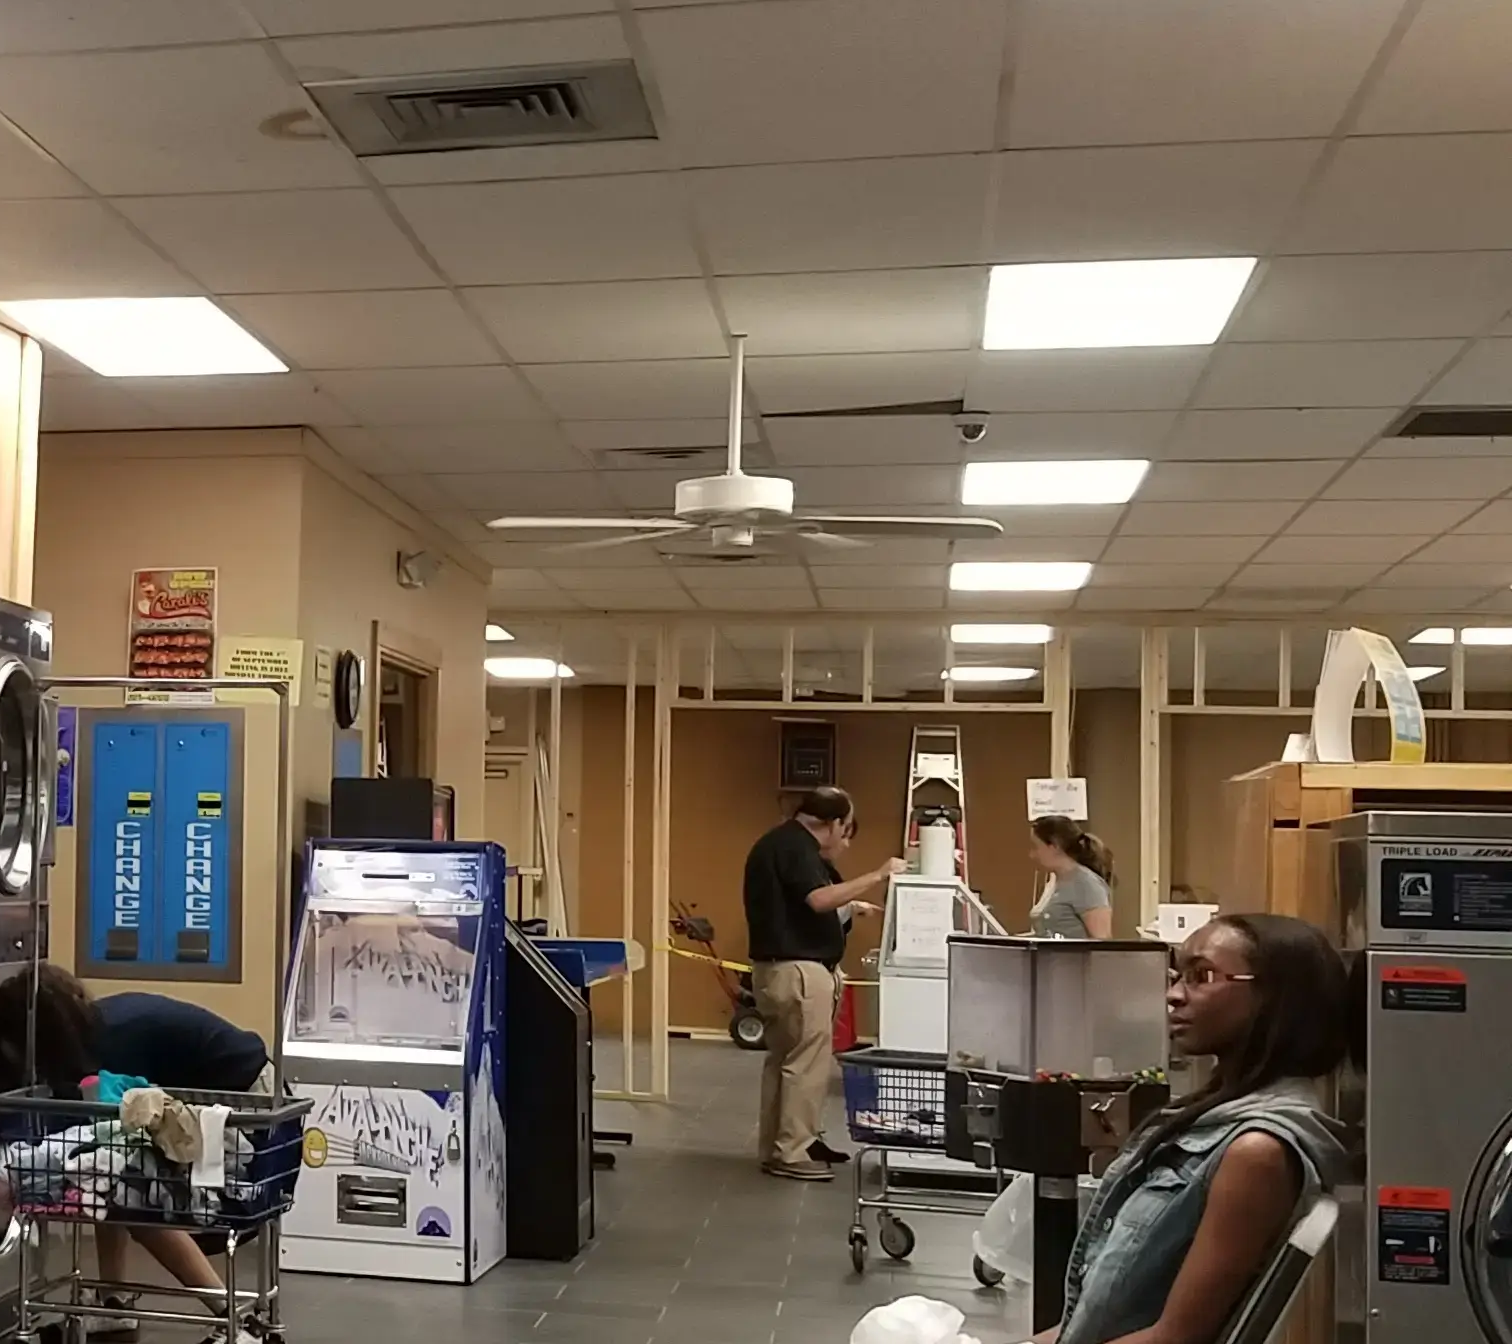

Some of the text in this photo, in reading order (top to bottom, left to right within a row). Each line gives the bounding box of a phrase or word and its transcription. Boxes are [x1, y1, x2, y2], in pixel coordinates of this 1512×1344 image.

[115, 821, 141, 927] CHANGE
[185, 822, 212, 929] CHANGE
[1382, 846, 1421, 856] TRIPLE
[1426, 847, 1458, 857] LOAD
